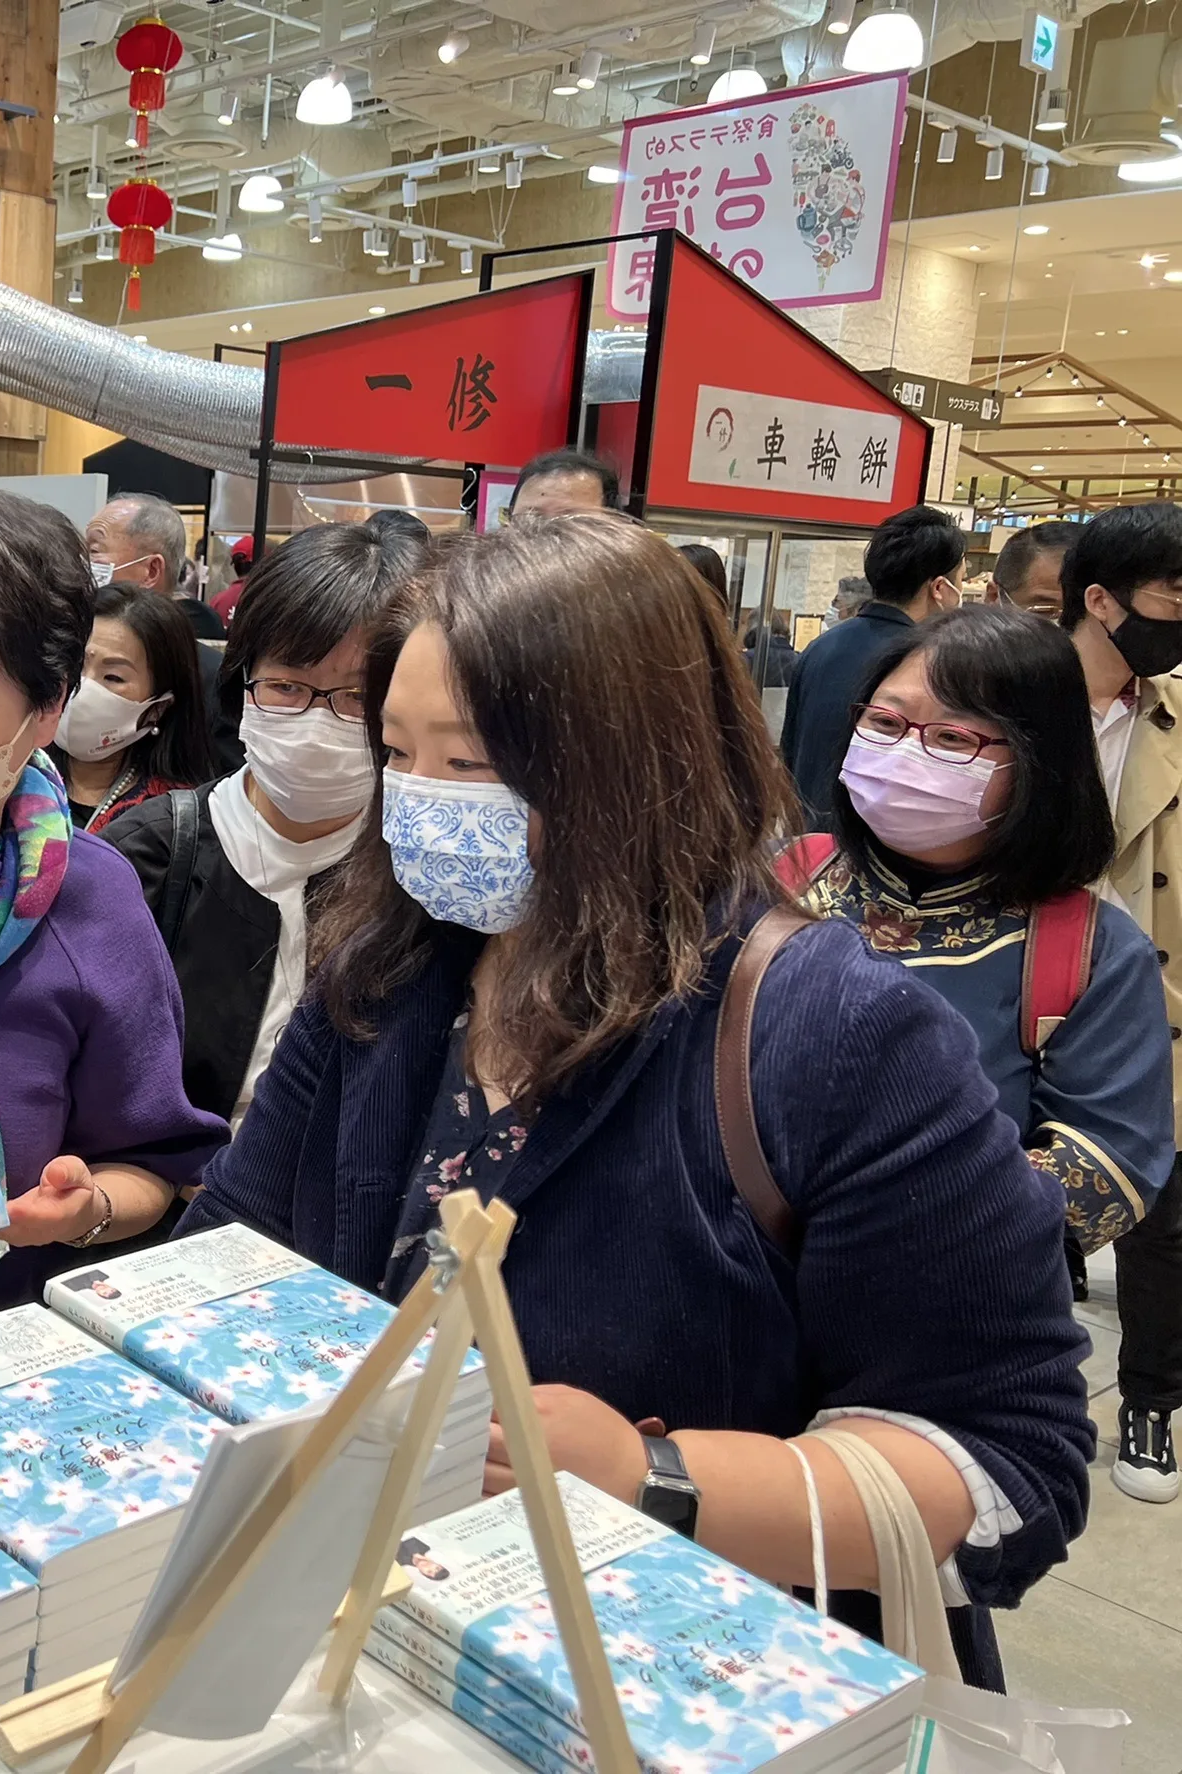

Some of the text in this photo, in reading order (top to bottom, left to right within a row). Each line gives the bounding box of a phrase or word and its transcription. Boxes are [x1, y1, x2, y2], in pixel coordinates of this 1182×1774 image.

[365, 352, 498, 432] 一修
[756, 416, 888, 489] 車輪餅
[9, 1415, 154, 1474] スケッチブック
[52, 1437, 150, 1479] 台湾客家
